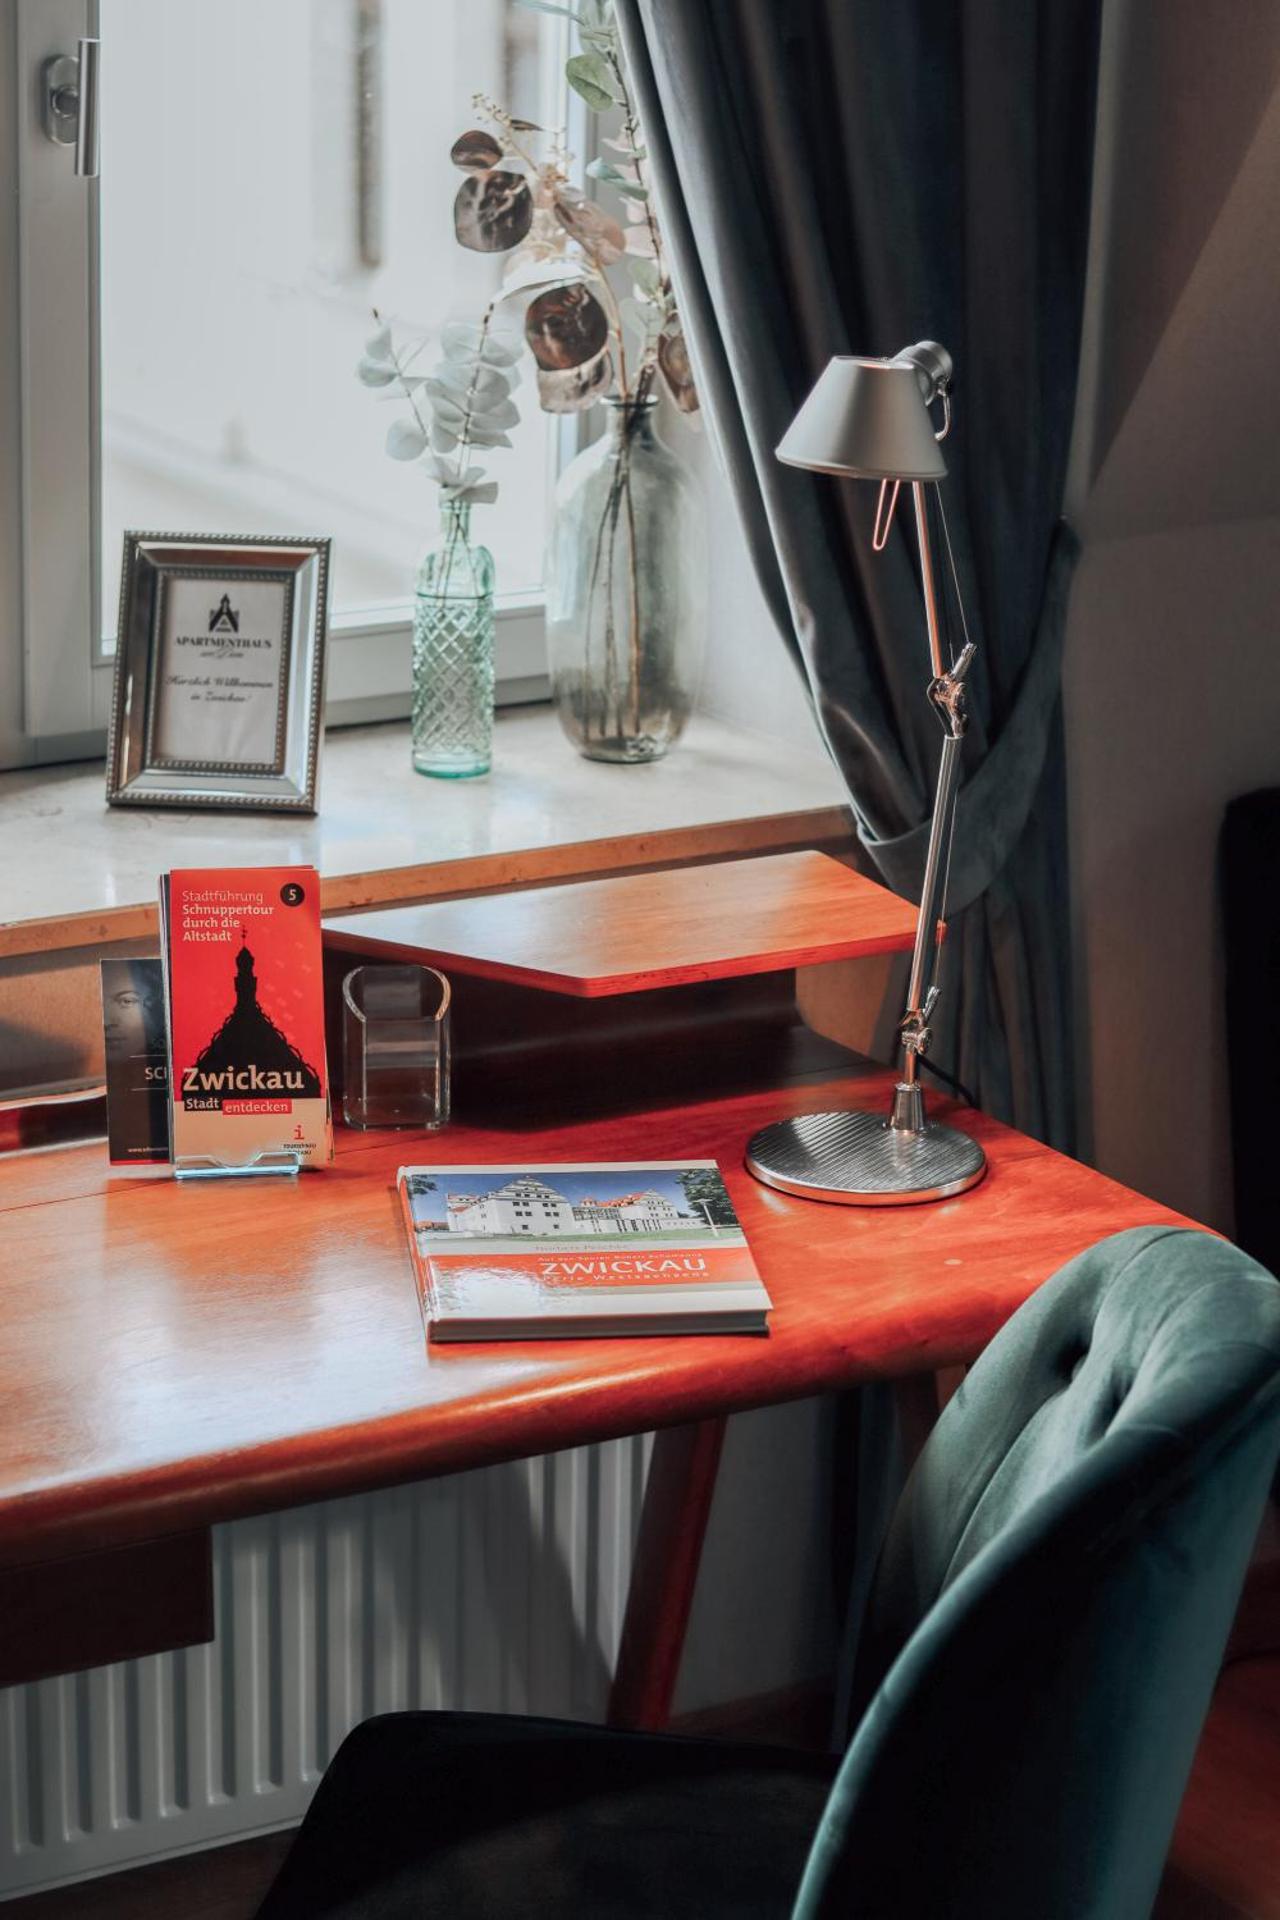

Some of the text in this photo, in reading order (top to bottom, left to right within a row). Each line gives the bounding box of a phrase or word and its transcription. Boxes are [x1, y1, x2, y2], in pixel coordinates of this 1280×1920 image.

[176, 636, 272, 648] APARTMENTHAUS
[182, 890, 264, 904] Stadtführung
[288, 889, 297, 901] 5
[182, 904, 275, 917] Schnuppertour
[182, 917, 240, 928] durch die
[183, 930, 233, 942] Altstadt
[183, 1065, 305, 1092] Zwickau
[186, 1098, 289, 1114] Stadt entdecken
[540, 1258, 707, 1275] ZWICKAU
